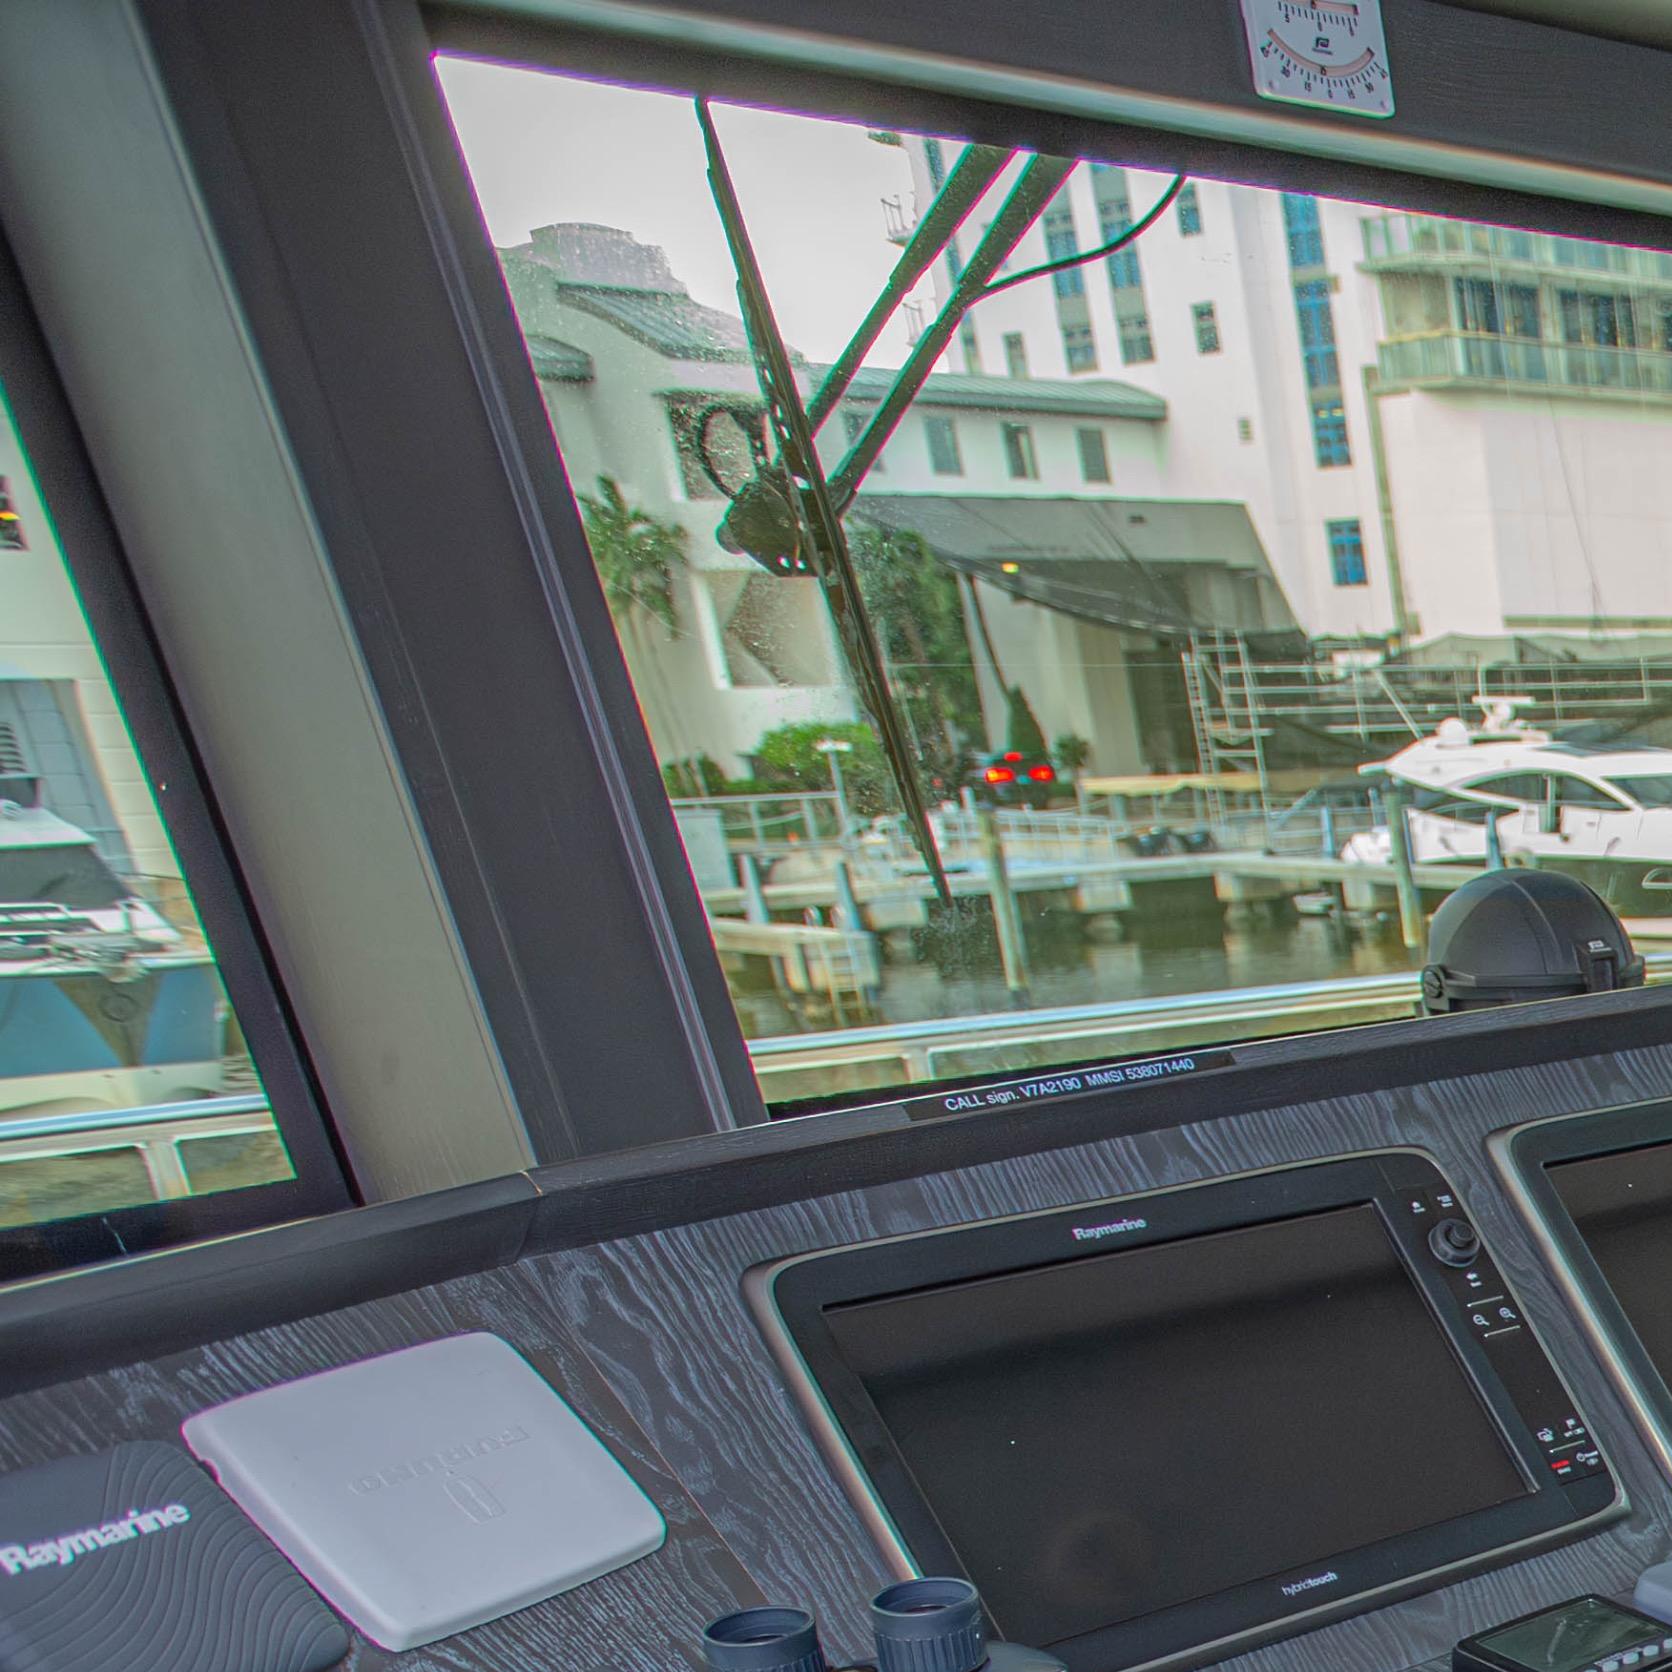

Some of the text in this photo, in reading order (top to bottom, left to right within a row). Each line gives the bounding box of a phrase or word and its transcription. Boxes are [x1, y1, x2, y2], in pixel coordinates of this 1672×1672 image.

[944, 1058, 1195, 1112] CALL sign. V7A2190 MMSI 538071440
[1072, 1218, 1147, 1240] Raymarine
[0, 1503, 192, 1575] Raymarine
[1281, 1571, 1339, 1597] hybridtouch
